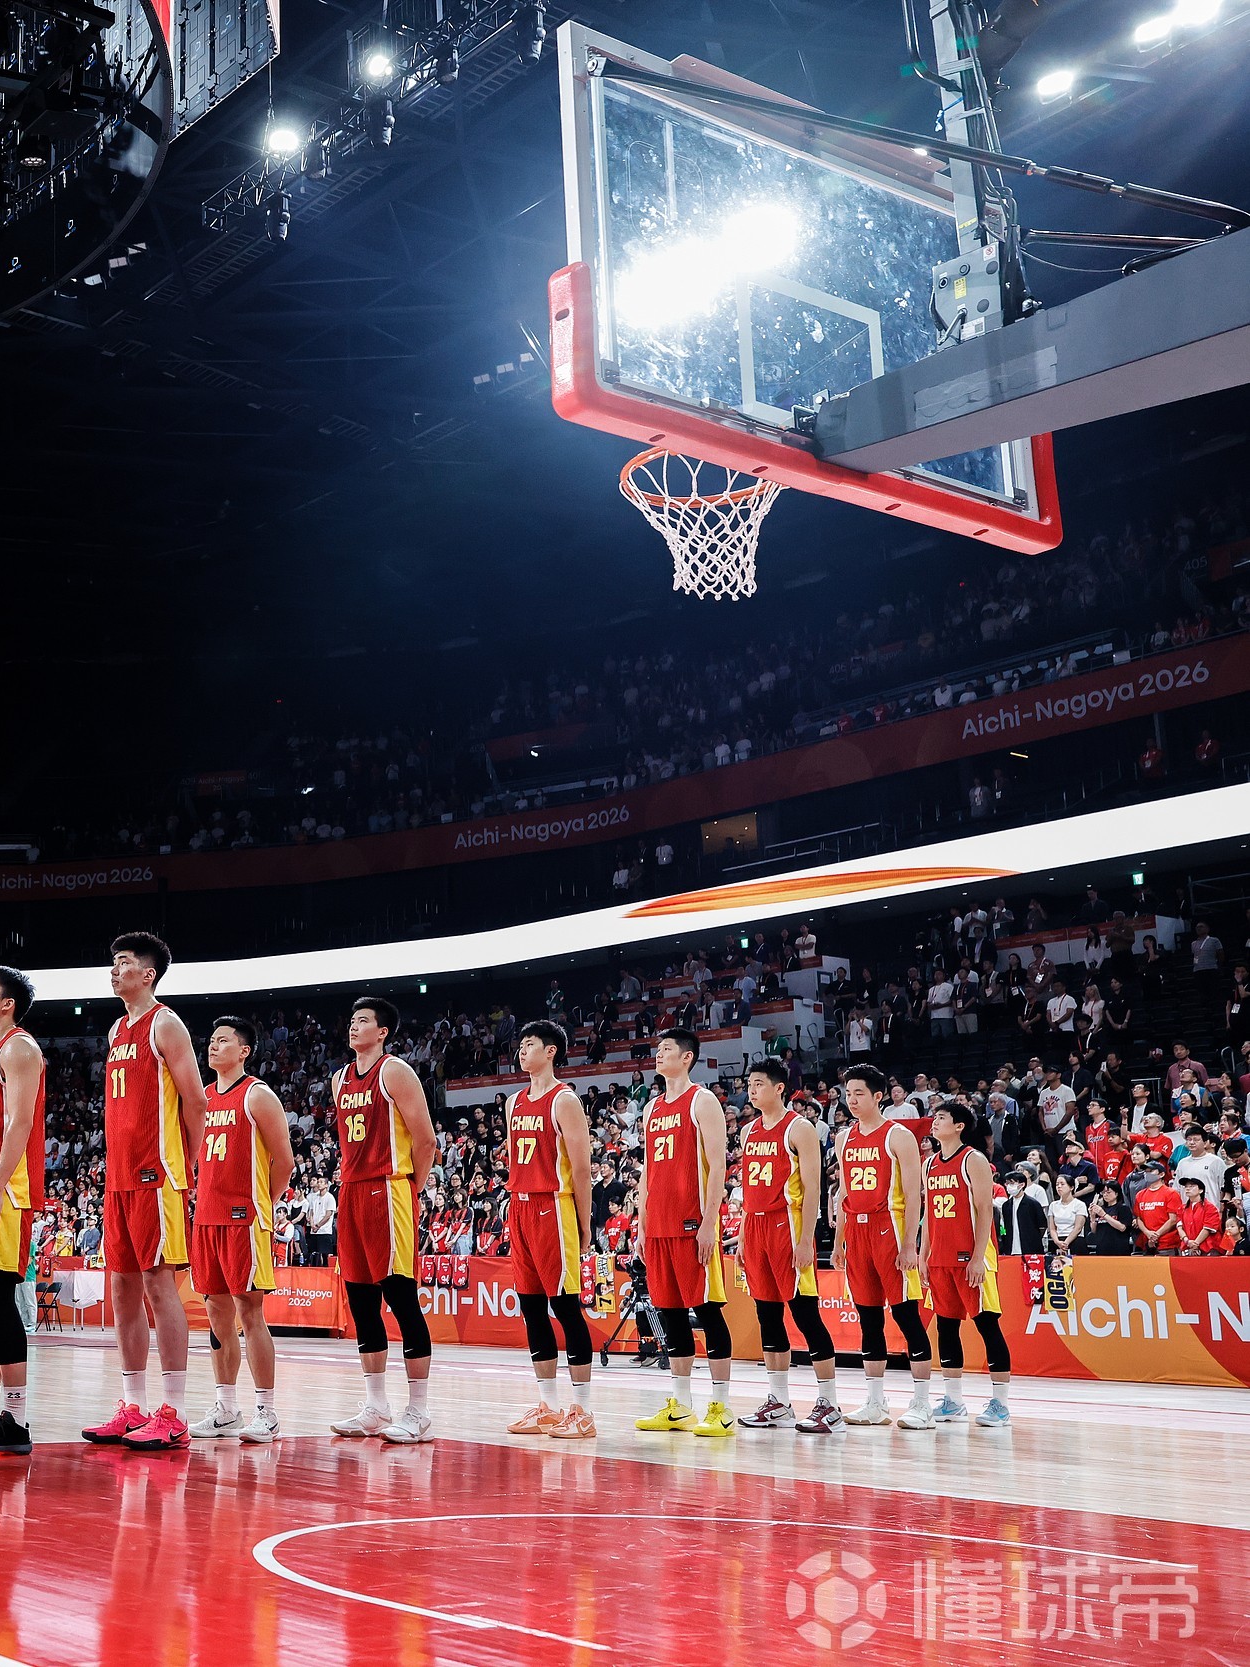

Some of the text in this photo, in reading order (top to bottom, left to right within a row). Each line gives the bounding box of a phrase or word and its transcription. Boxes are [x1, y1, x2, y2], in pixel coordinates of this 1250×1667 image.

[961, 660, 1209, 741] Aichi-Nagoya 2026
[453, 804, 630, 852] Aichi-Nagoya 2026
[110, 866, 154, 884] 2026
[108, 1043, 137, 1062] CHINA
[111, 1068, 125, 1099] 11
[340, 1090, 372, 1110] CHINA
[204, 1109, 236, 1127] CHINA
[345, 1114, 366, 1142] 16
[512, 1116, 543, 1132] CHINA
[649, 1113, 681, 1132] CHINA
[205, 1133, 227, 1162] 14
[517, 1138, 536, 1164] 17
[654, 1136, 674, 1162] 21
[745, 1141, 777, 1156] CHINA
[845, 1146, 880, 1162] CHINA
[748, 1162, 773, 1186] 24
[850, 1167, 876, 1191] 26
[928, 1174, 958, 1190] CHINA
[933, 1195, 955, 1218] 32
[287, 1297, 312, 1308] 2026
